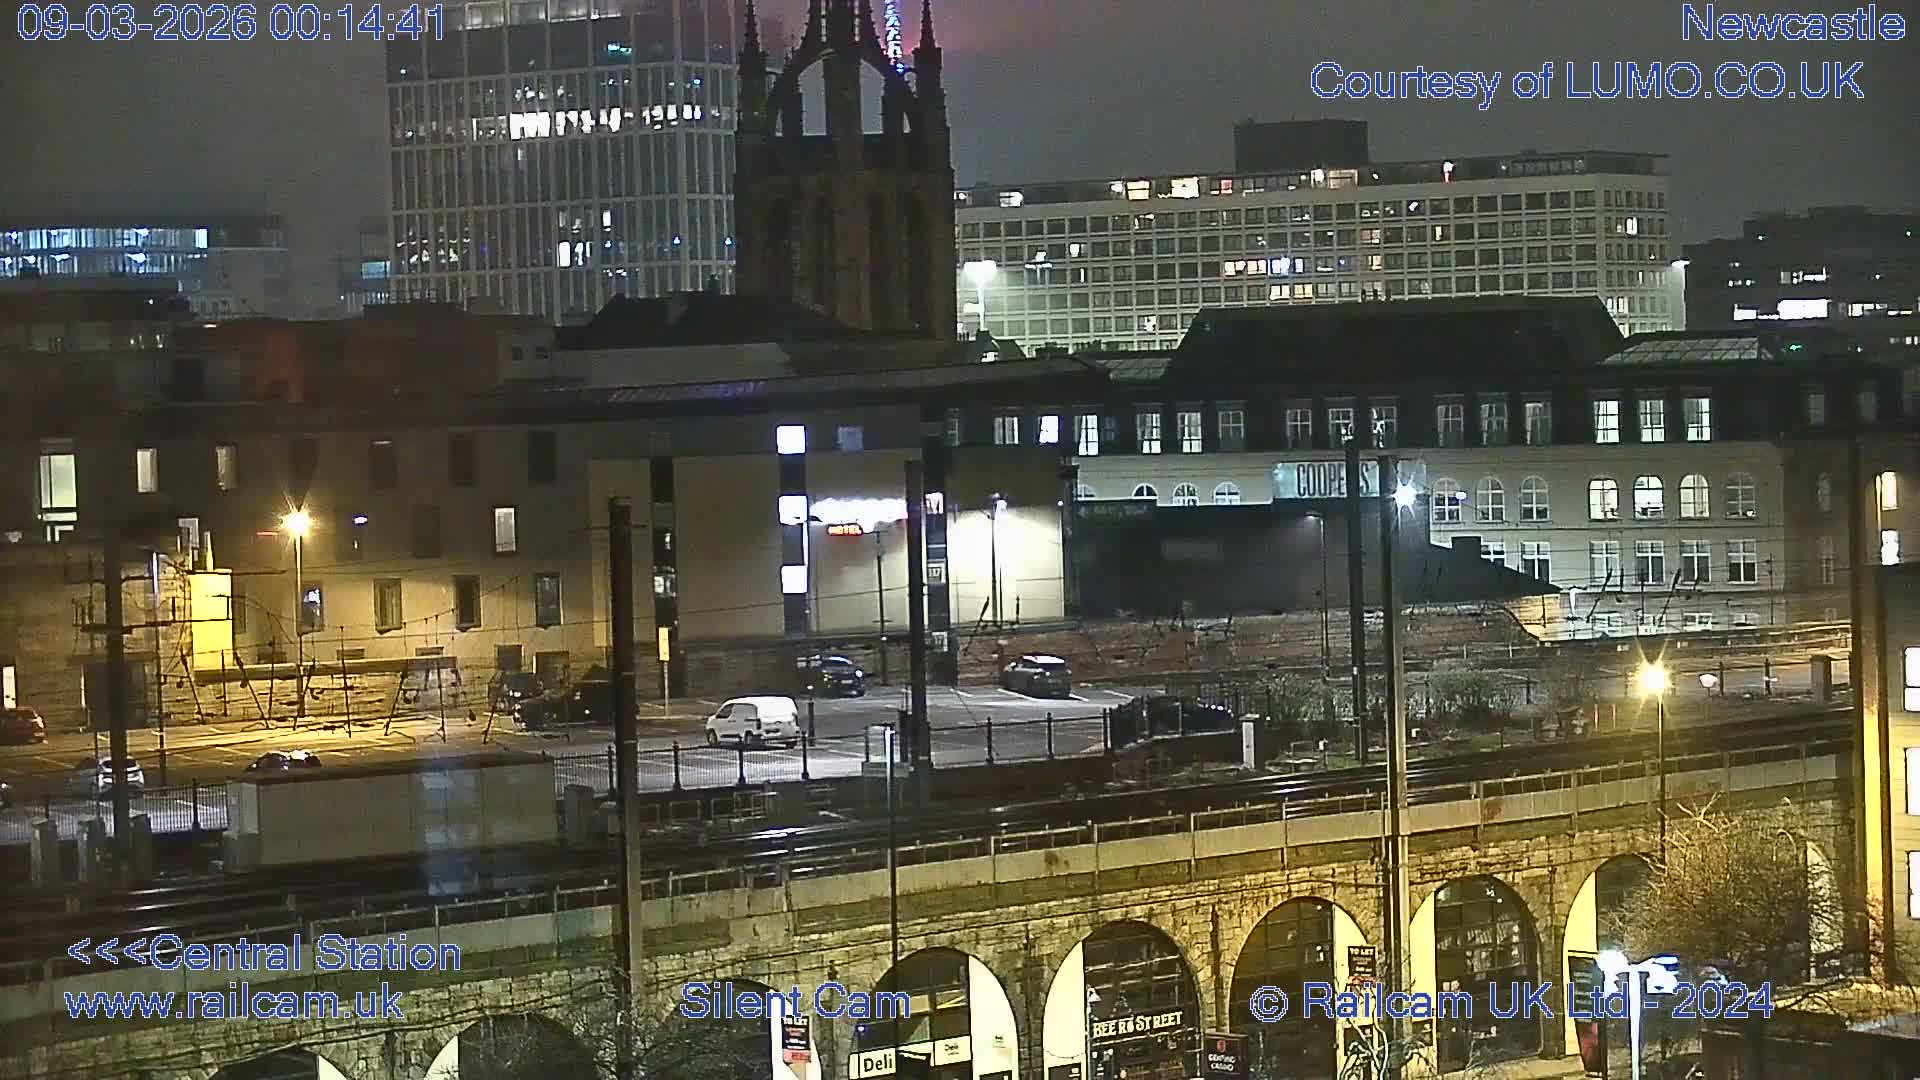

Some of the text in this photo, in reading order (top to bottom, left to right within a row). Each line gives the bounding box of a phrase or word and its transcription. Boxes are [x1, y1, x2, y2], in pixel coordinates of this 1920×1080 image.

[1297, 463, 1371, 497] COOPES
[1135, 1010, 1184, 1032] STREET
[944, 1042, 959, 1052] Deli
[864, 1053, 893, 1073] Deli
